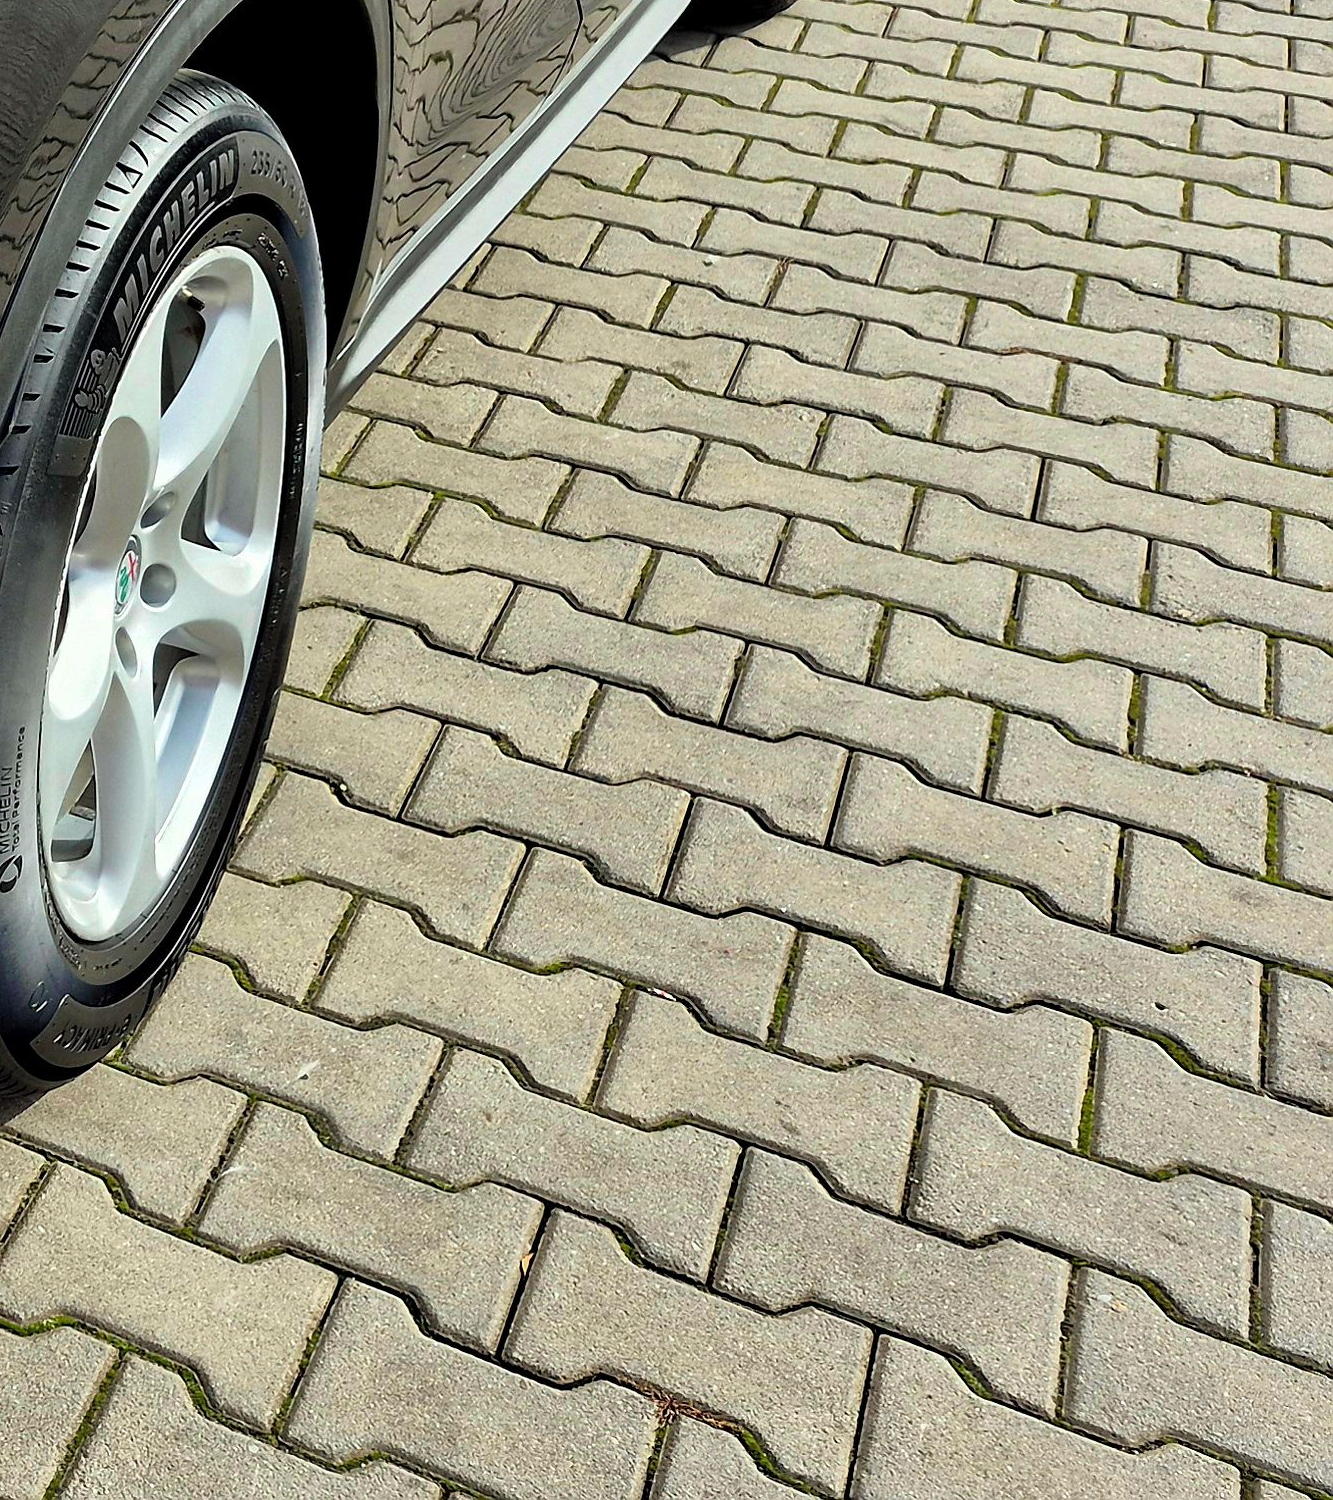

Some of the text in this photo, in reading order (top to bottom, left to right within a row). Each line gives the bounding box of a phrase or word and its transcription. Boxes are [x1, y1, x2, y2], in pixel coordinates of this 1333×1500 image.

[113, 148, 235, 344] MICHELIN
[0, 767, 13, 855] MICHELIN
[11, 726, 26, 853] Total Performance
